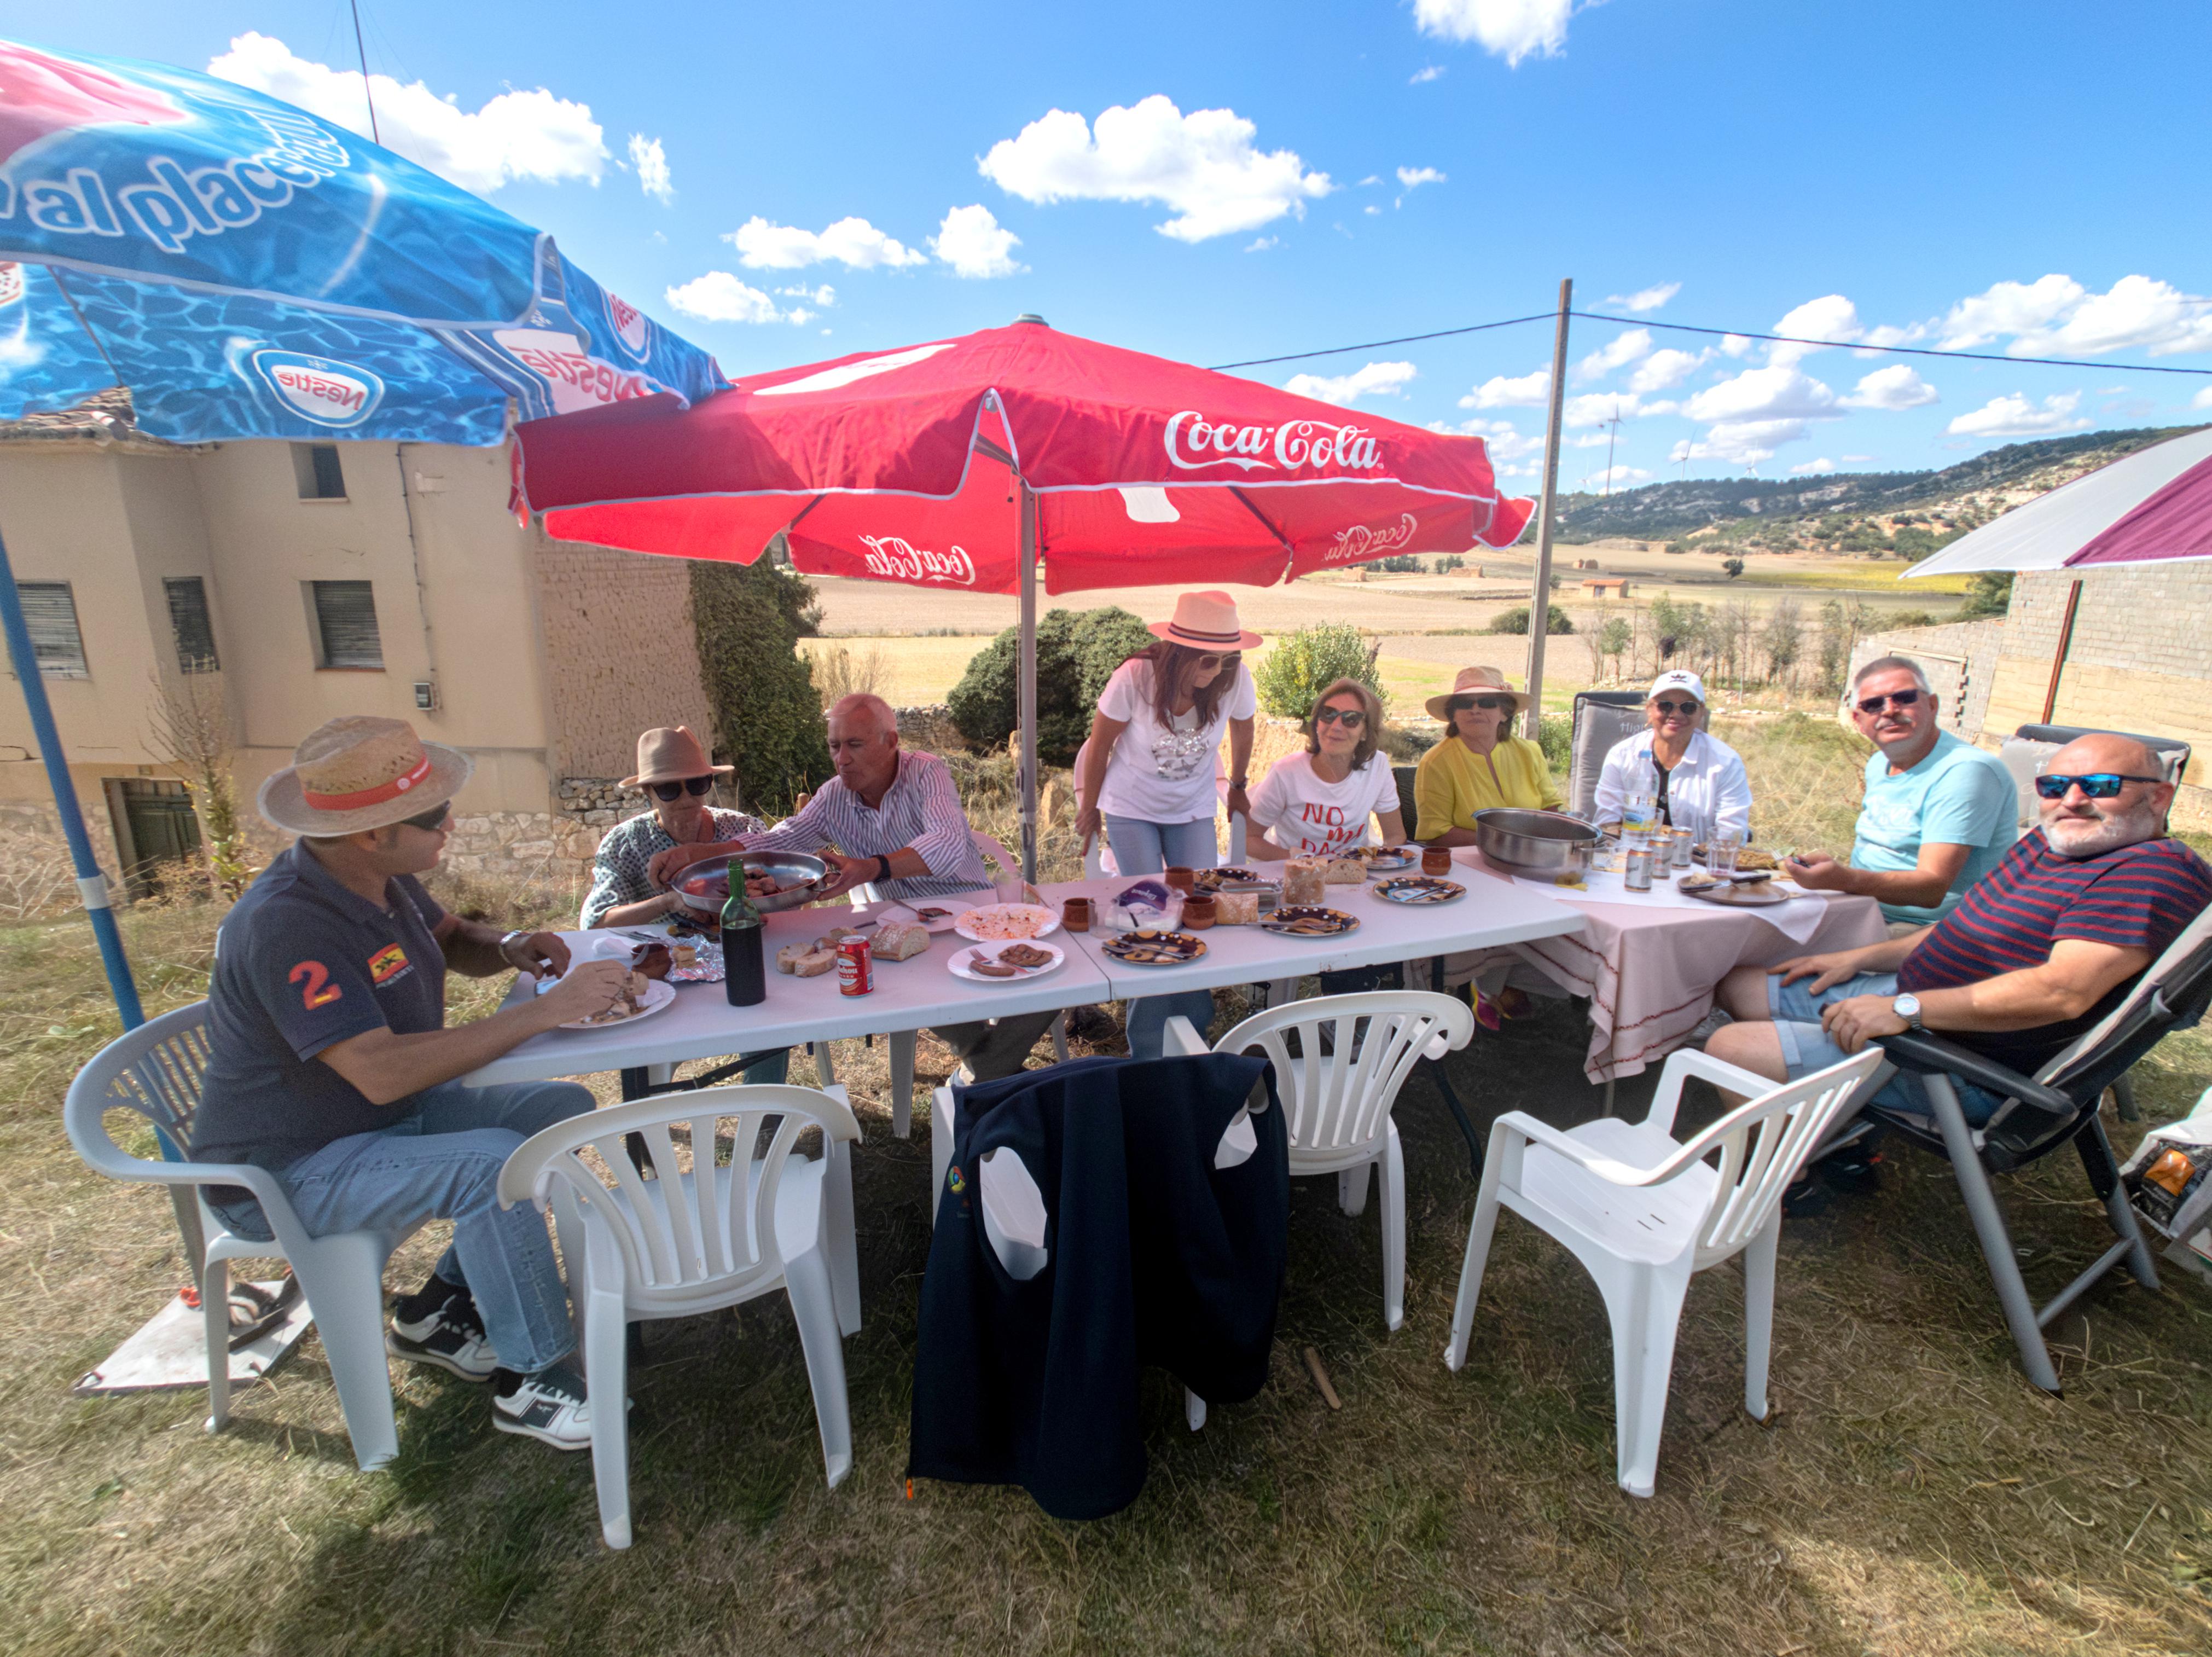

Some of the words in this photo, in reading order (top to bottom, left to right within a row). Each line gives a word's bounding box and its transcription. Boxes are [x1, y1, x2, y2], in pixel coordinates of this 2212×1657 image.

[22, 167, 125, 237] al
[117, 147, 337, 254] placer
[1164, 411, 1381, 471] Coca-Cola
[1302, 802, 1344, 827] NO
[288, 960, 342, 1011] 2
